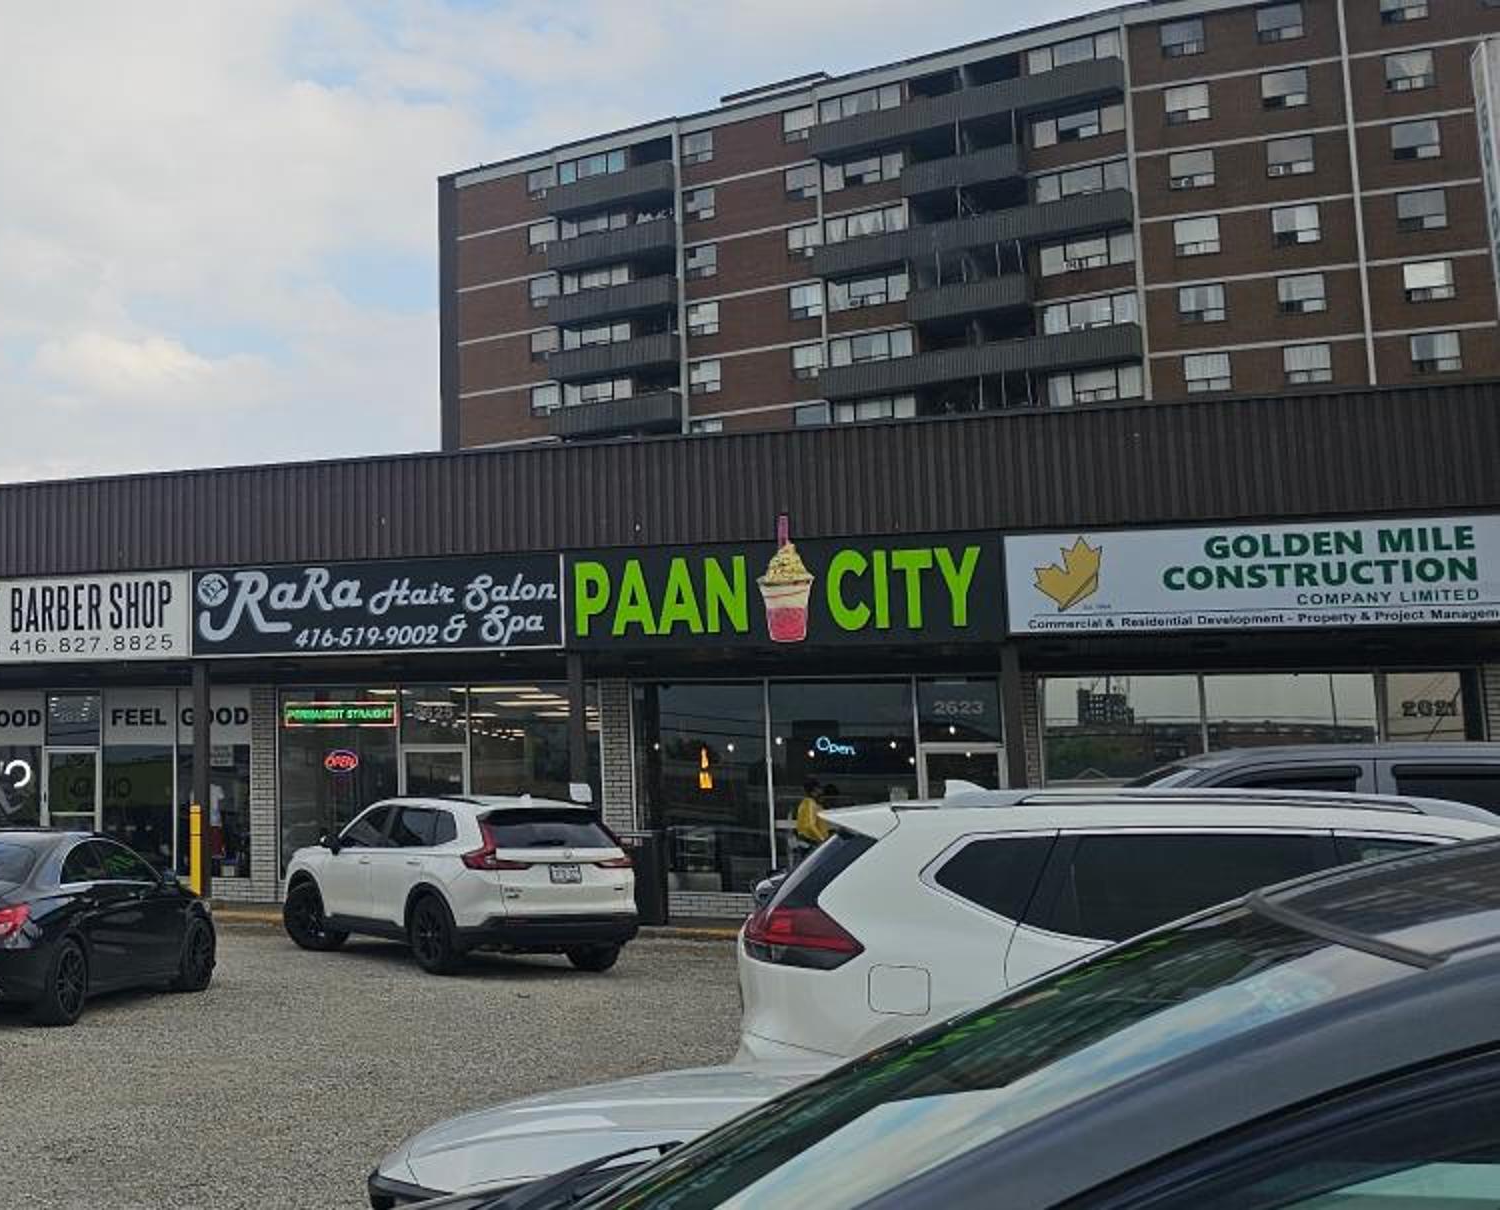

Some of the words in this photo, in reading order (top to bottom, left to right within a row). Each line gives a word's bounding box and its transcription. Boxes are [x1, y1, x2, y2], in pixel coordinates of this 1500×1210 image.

[1203, 530, 1364, 560] GOLDEN
[1377, 525, 1475, 554] MILE
[1162, 556, 1478, 591] CONSTRUCTION
[574, 555, 749, 636] PAAN
[826, 546, 980, 631] CITY
[1297, 592, 1391, 605] COMPANY
[1400, 589, 1479, 603] LIMITED
[10, 583, 100, 634] BARBER
[109, 580, 173, 629] SHOP
[199, 567, 363, 642] RaRa
[369, 579, 455, 615] Hair
[464, 574, 557, 612] Salon
[295, 625, 438, 648] 416-519-9002
[442, 613, 467, 643] &
[481, 605, 544, 645] Spa
[1028, 619, 1101, 630] Commercial
[1105, 618, 1115, 628] &
[1121, 616, 1193, 627] Residential
[1197, 614, 1284, 627] Development
[1298, 614, 1356, 625] Property
[1360, 612, 1370, 621] &
[1375, 610, 1424, 622] Project
[9, 634, 174, 655] 416.827.8825
[111, 709, 167, 726] FEEL
[347, 707, 394, 719] STRAIGHT
[932, 701, 984, 715] 2623
[816, 736, 856, 755] Open
[325, 755, 357, 768] OPEN
